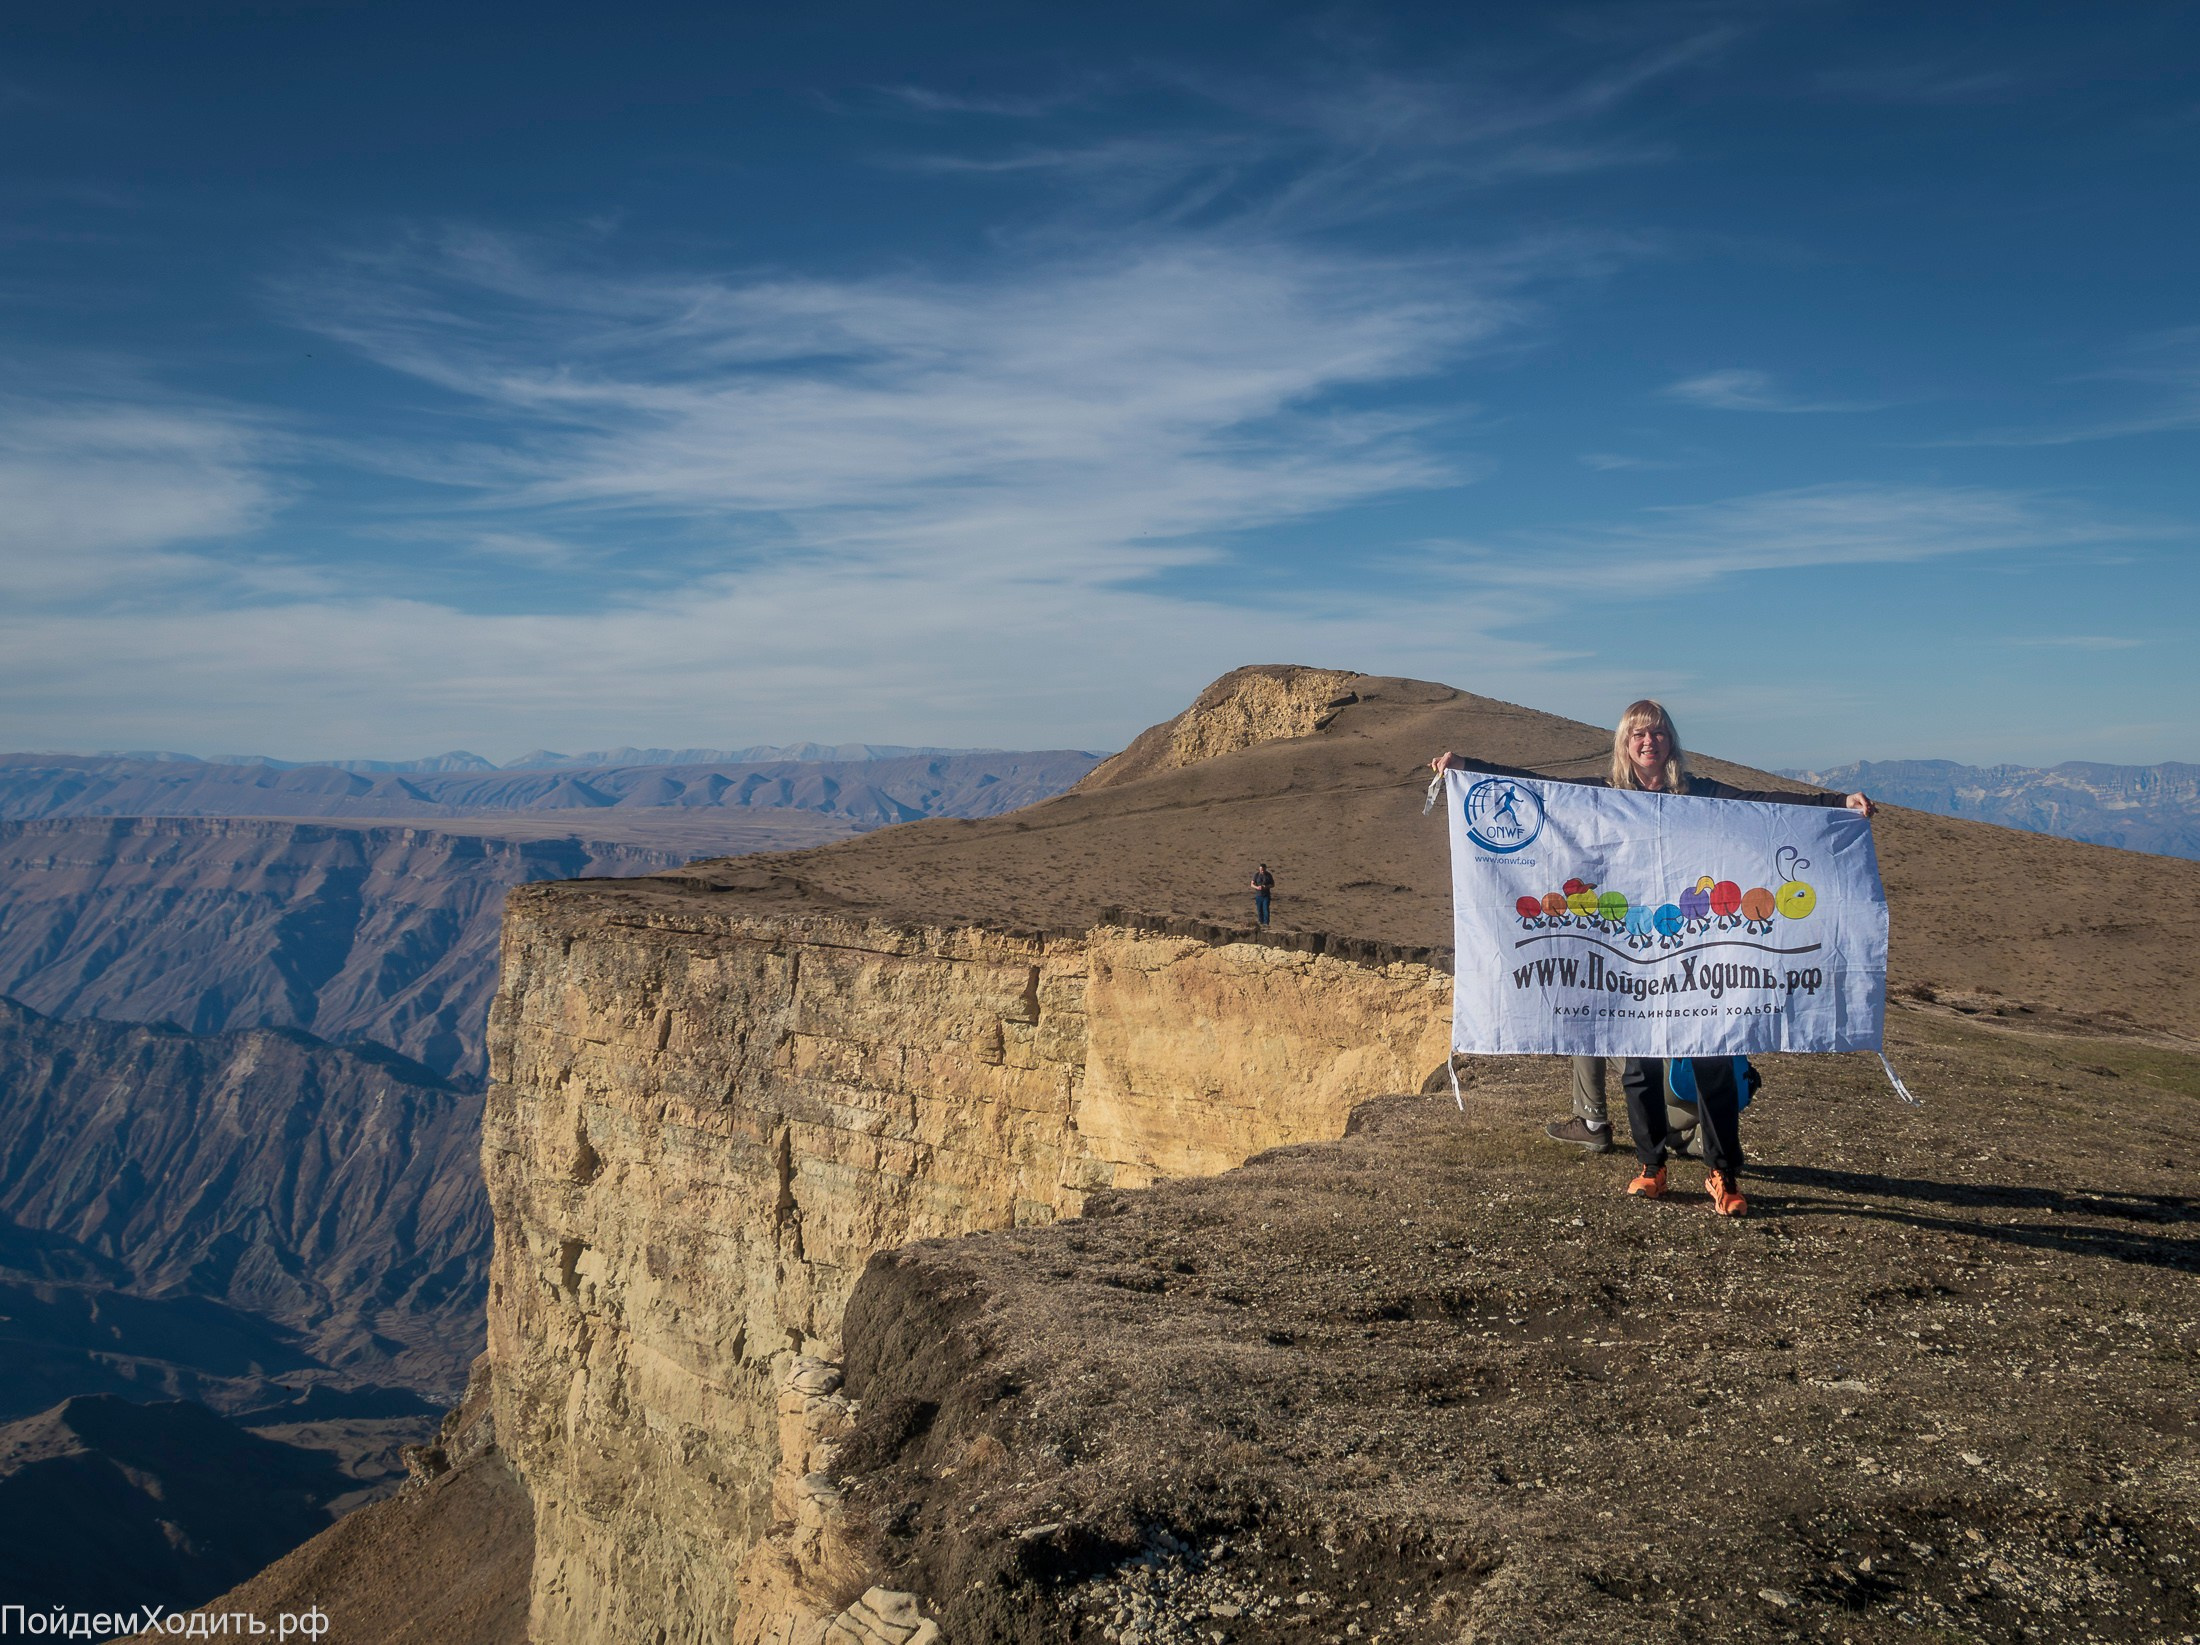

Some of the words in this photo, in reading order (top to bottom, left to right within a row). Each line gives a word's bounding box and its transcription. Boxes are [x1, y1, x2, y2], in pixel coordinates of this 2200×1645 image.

[1486, 825, 1526, 840] ONWF
[1474, 855, 1537, 868] www.onwf.org
[1554, 1005, 1591, 1017] клуб
[1598, 1004, 1719, 1019] скандинавской
[1726, 1002, 1785, 1017] ходьбы
